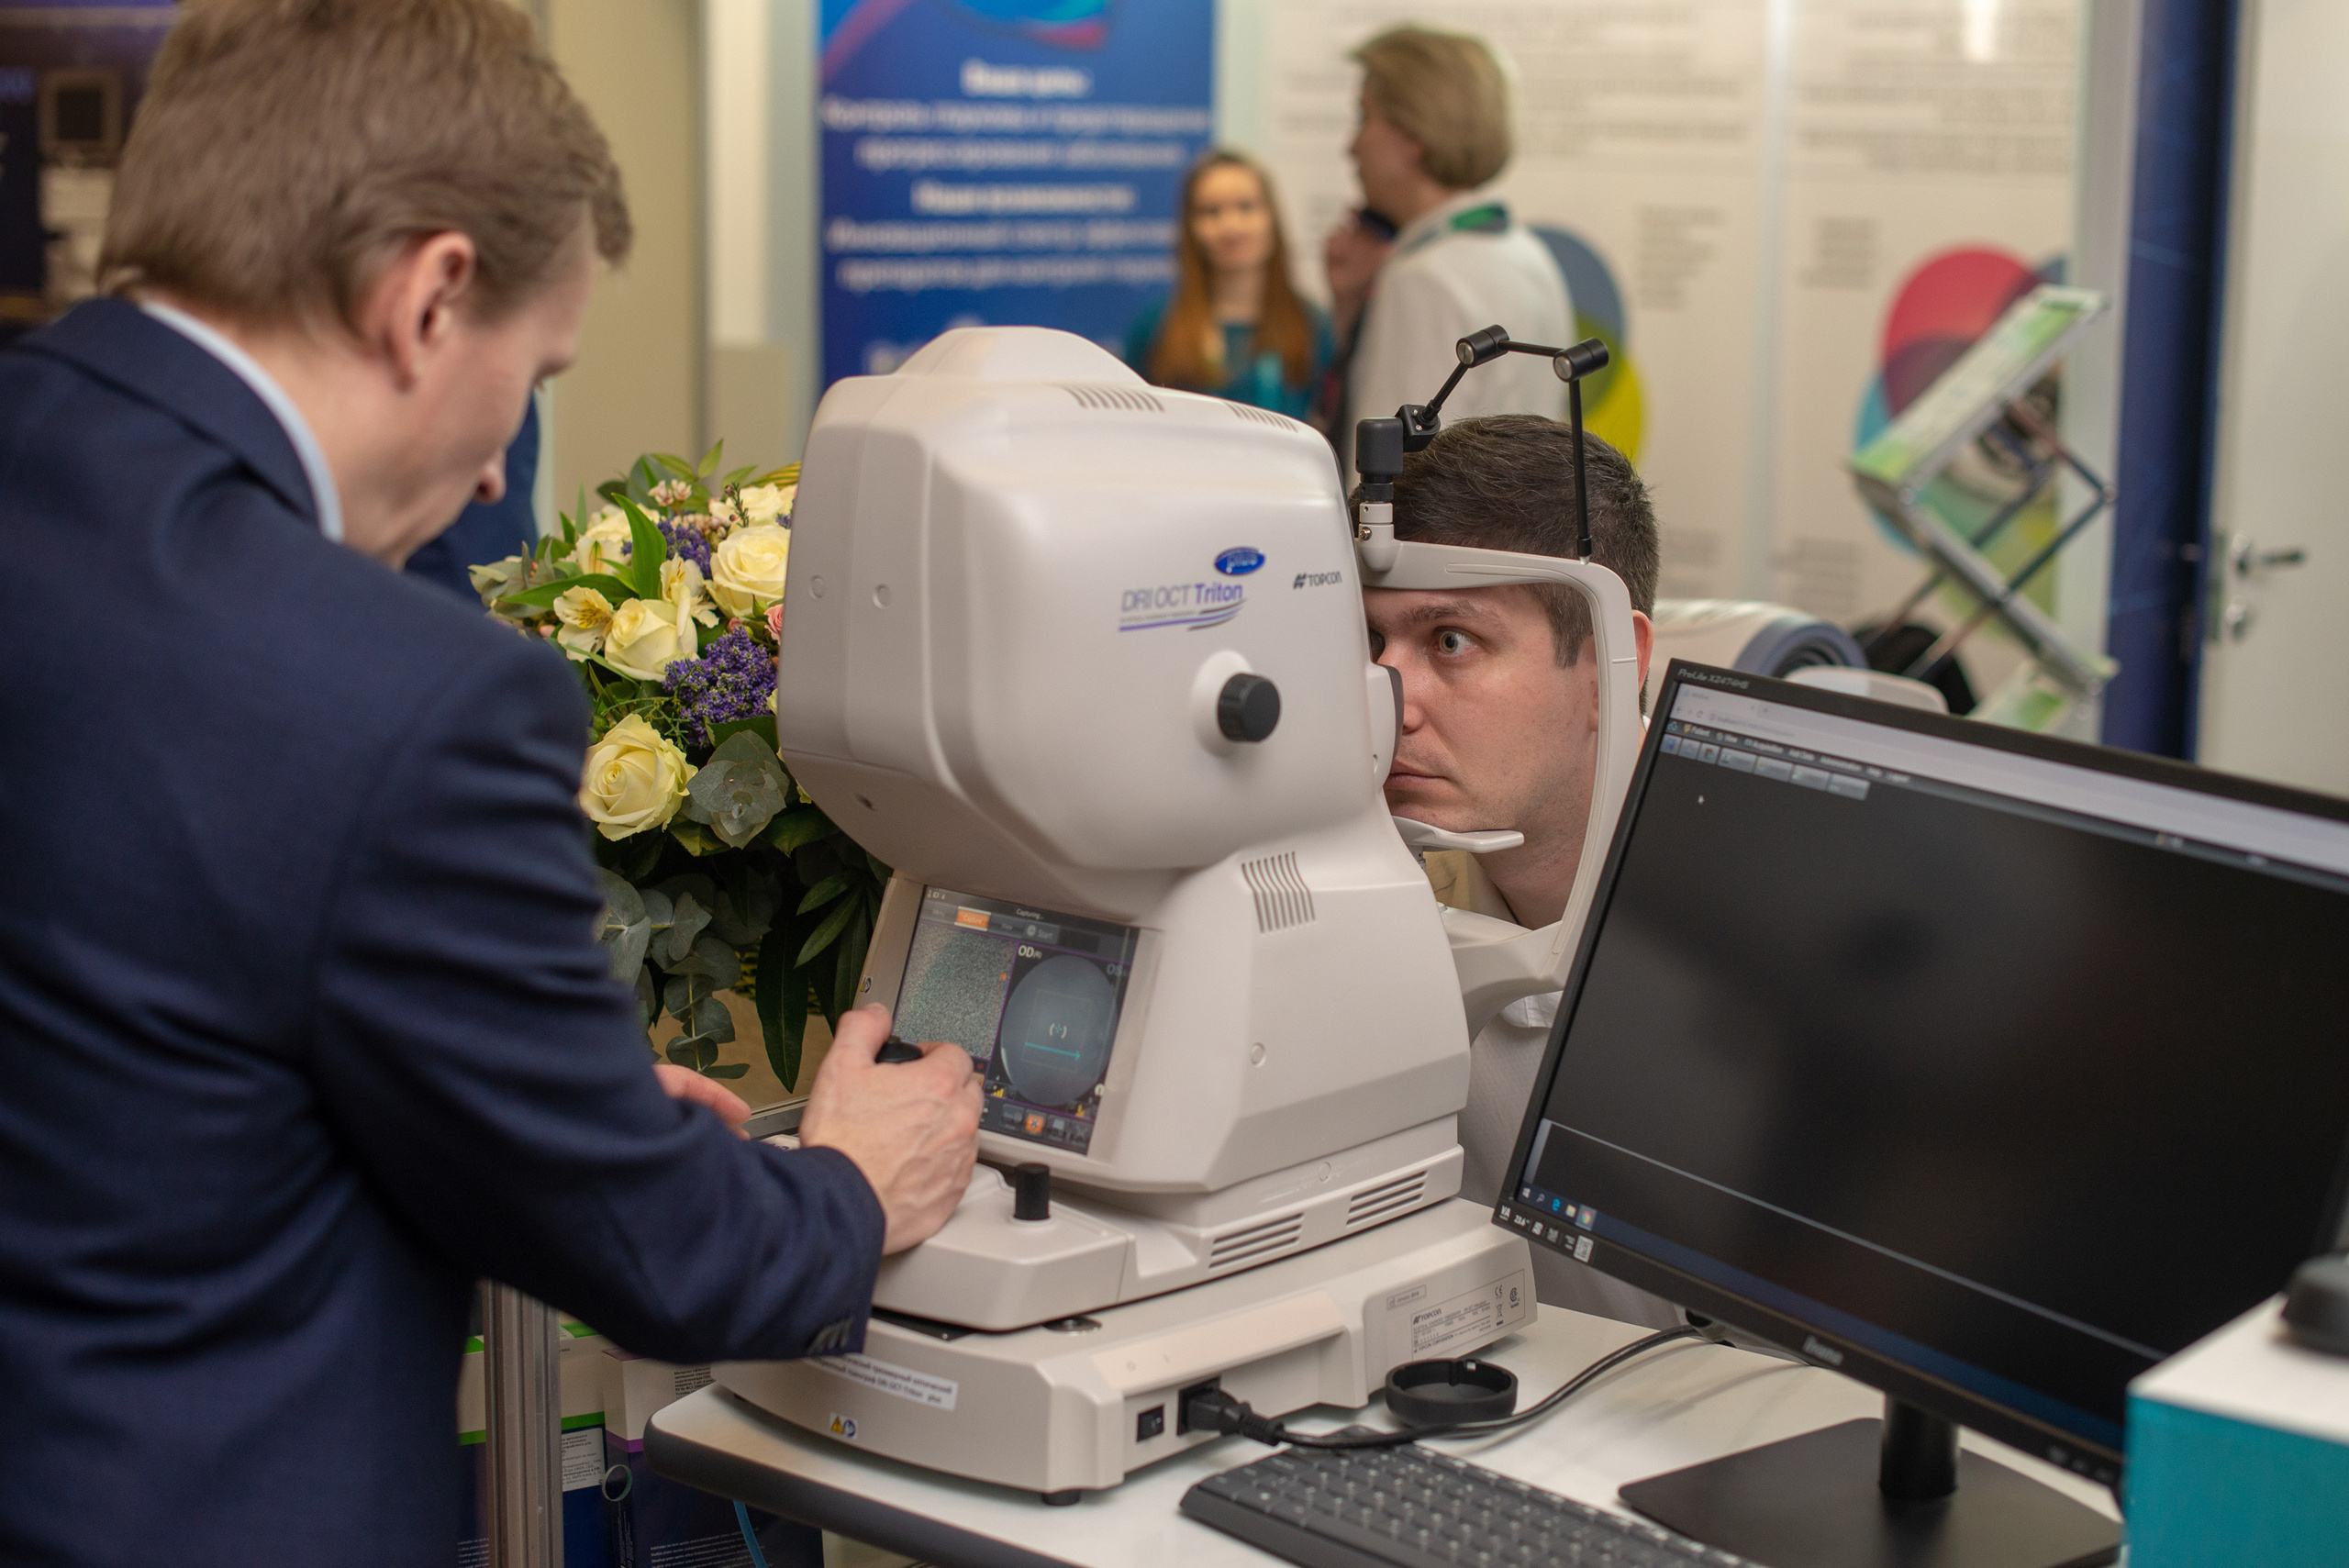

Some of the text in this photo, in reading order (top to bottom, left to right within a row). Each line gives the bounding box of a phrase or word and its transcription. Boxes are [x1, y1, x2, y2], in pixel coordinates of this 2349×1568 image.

[1225, 550, 1258, 573] plus
[1308, 571, 1342, 587] TOPCON
[1121, 581, 1244, 612] DRI OCT Triton
[1677, 668, 1708, 682] ProLite
[1420, 1308, 1442, 1321] TOPCON
